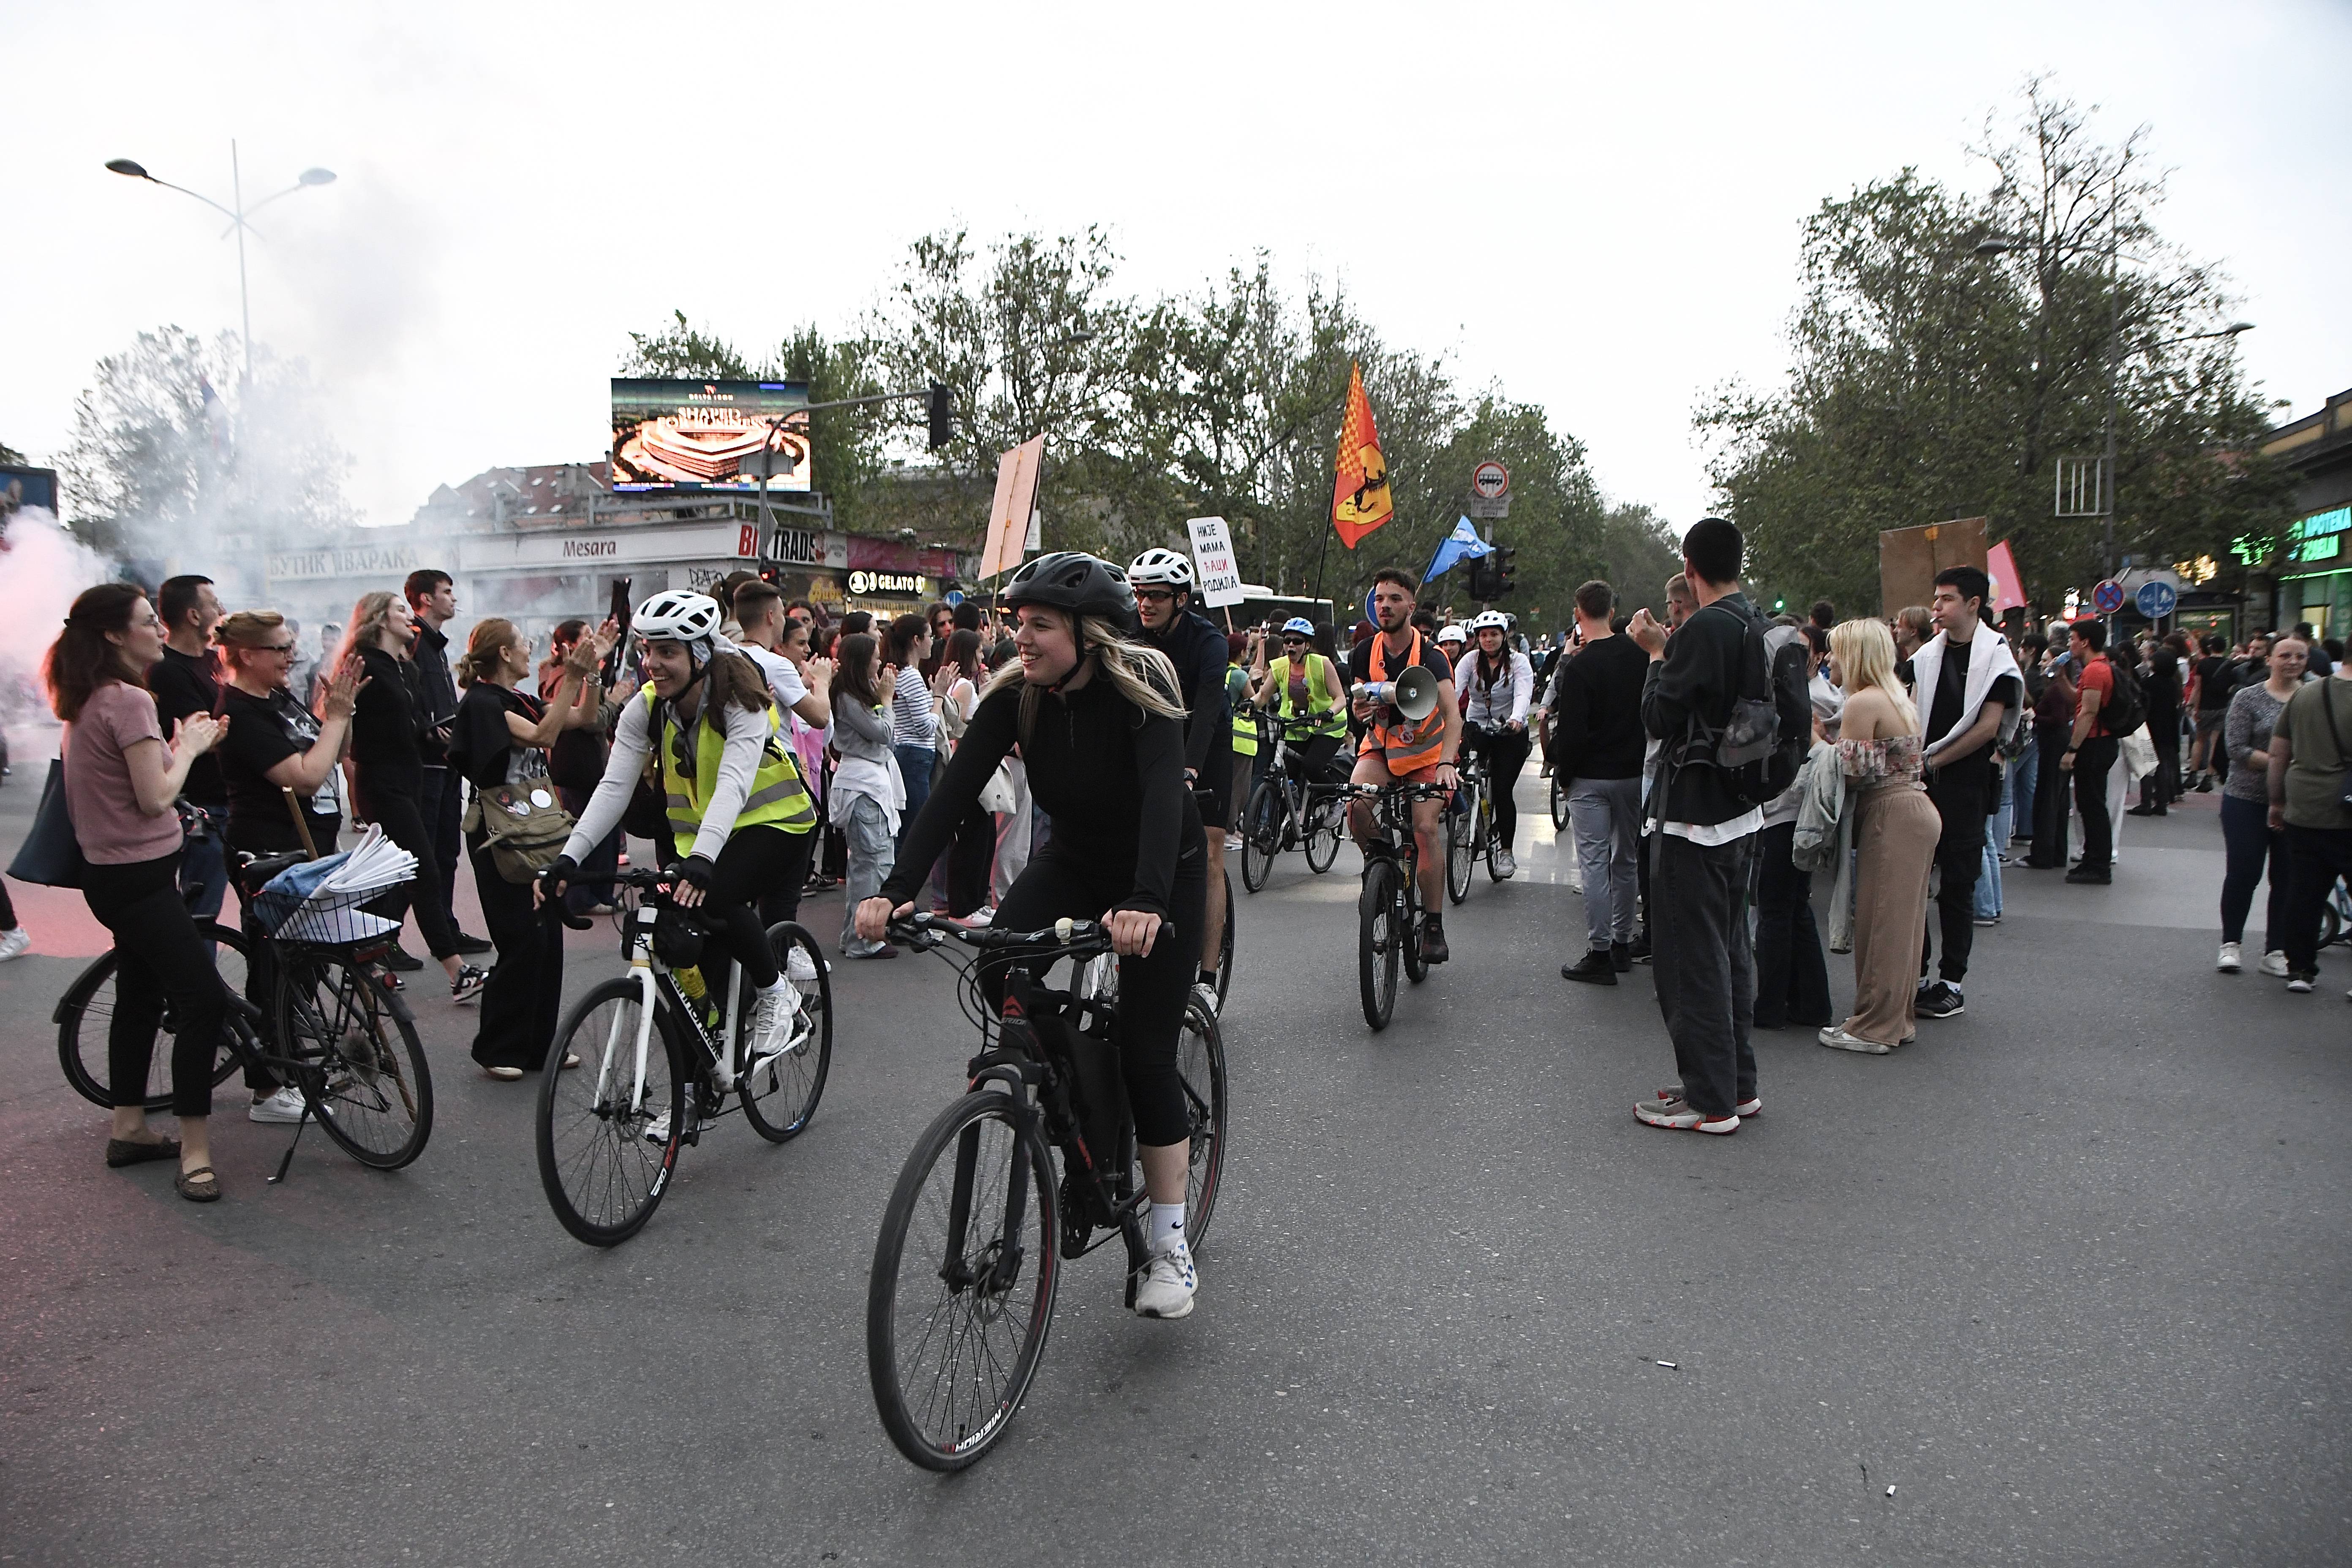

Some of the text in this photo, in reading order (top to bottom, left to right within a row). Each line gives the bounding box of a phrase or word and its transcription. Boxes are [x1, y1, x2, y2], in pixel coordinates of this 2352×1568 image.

[678, 407, 741, 420] SHAPED
[1197, 524, 1217, 537] НИЈЕ
[563, 540, 616, 557] Mesara
[738, 525, 759, 557] BI
[773, 530, 815, 562] TRADE
[1199, 541, 1225, 553] МАМА
[878, 574, 914, 591] GELATO
[1203, 575, 1237, 593] РОДИЛА
[955, 1408, 1002, 1453] MERIDA
